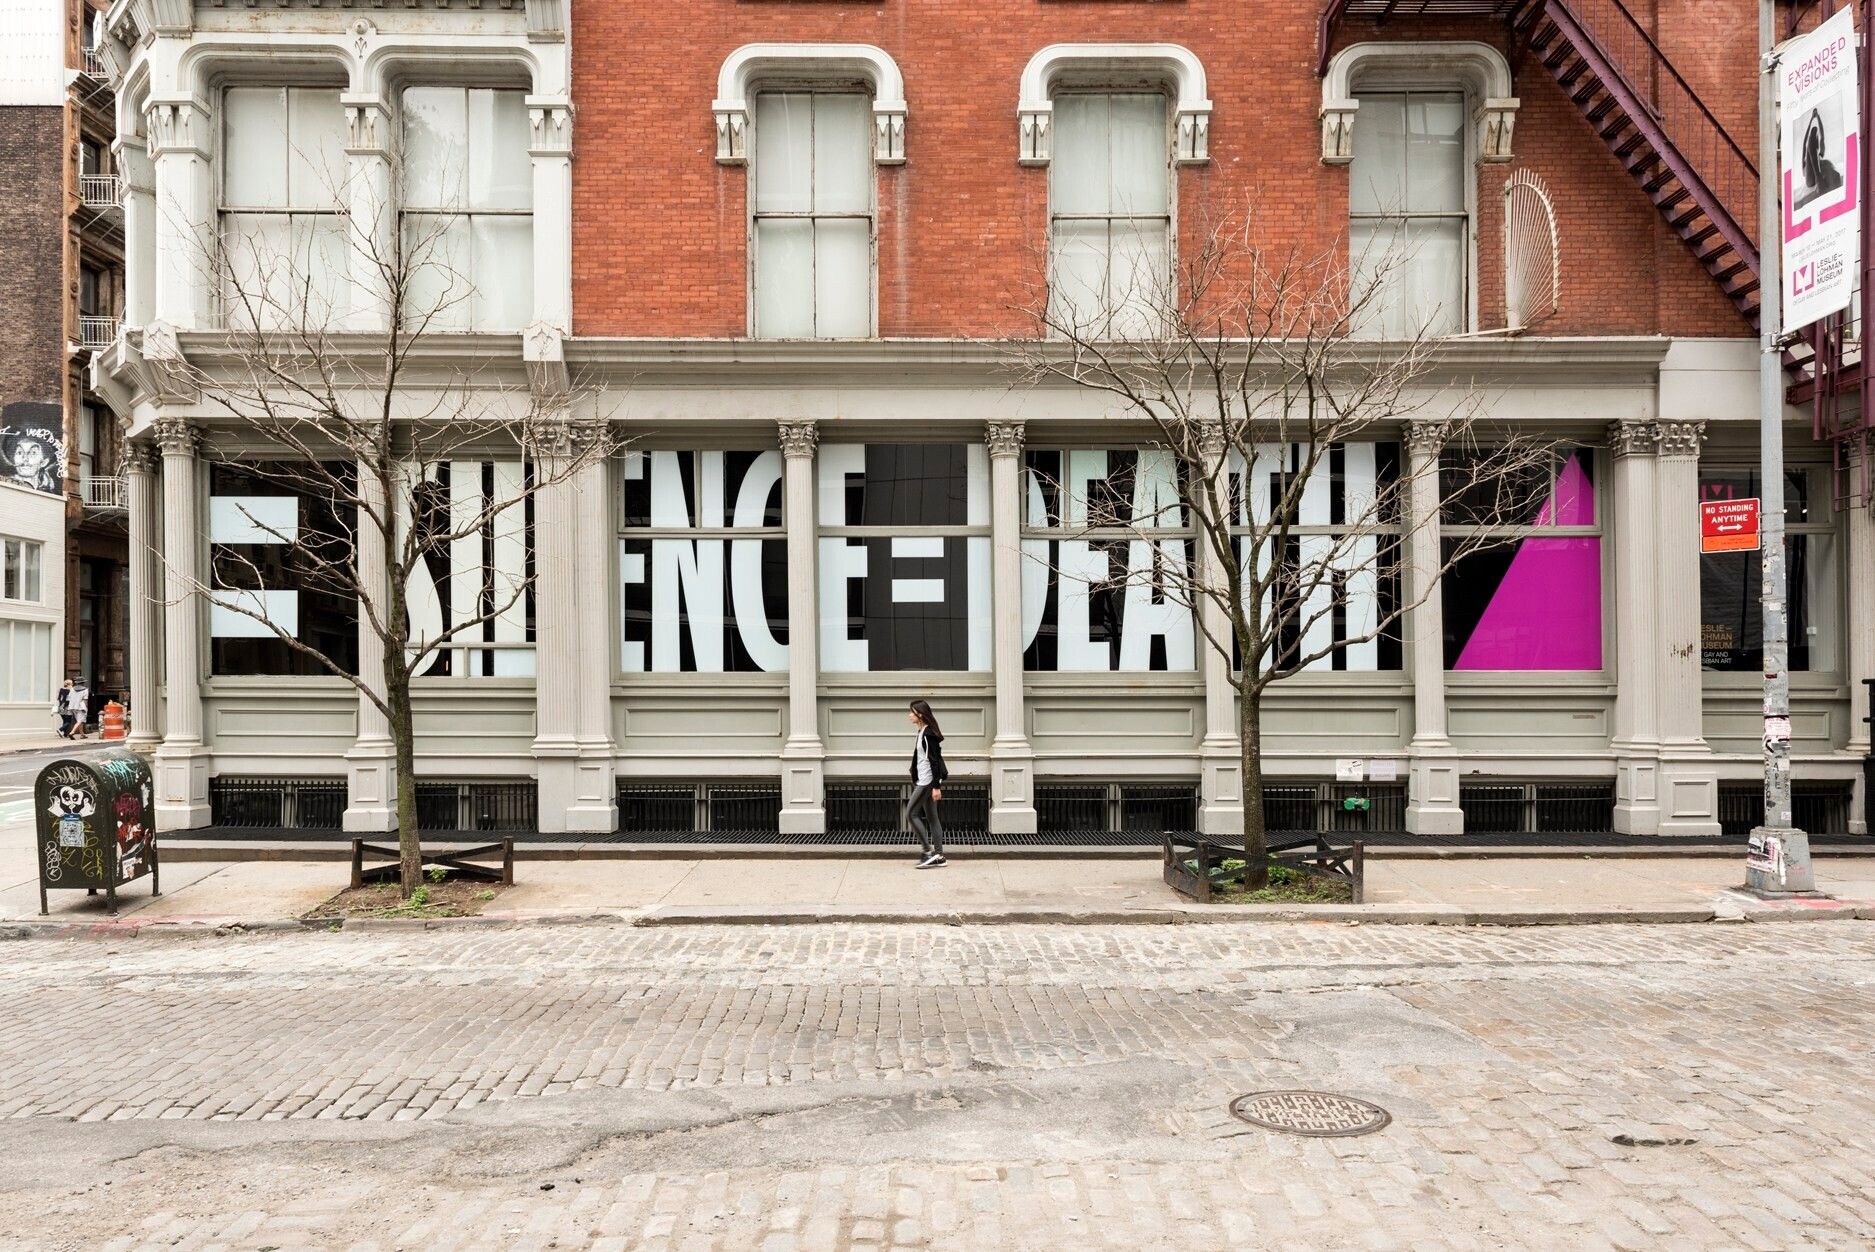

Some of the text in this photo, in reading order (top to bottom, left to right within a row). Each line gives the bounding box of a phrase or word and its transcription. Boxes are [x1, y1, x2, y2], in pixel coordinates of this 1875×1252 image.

[1788, 36, 1846, 86] EXPANDED
[1795, 56, 1838, 94] VISIONS
[1816, 260, 1843, 277] LOHMAN
[1816, 268, 1843, 285] MUSEUM
[1705, 503, 1754, 514] NO STANDING
[1711, 514, 1748, 523] ANYTIME
[1700, 633, 1733, 641] OHMAN
[1701, 641, 1733, 650] USEUM
[1701, 657, 1720, 665] SBIAN
